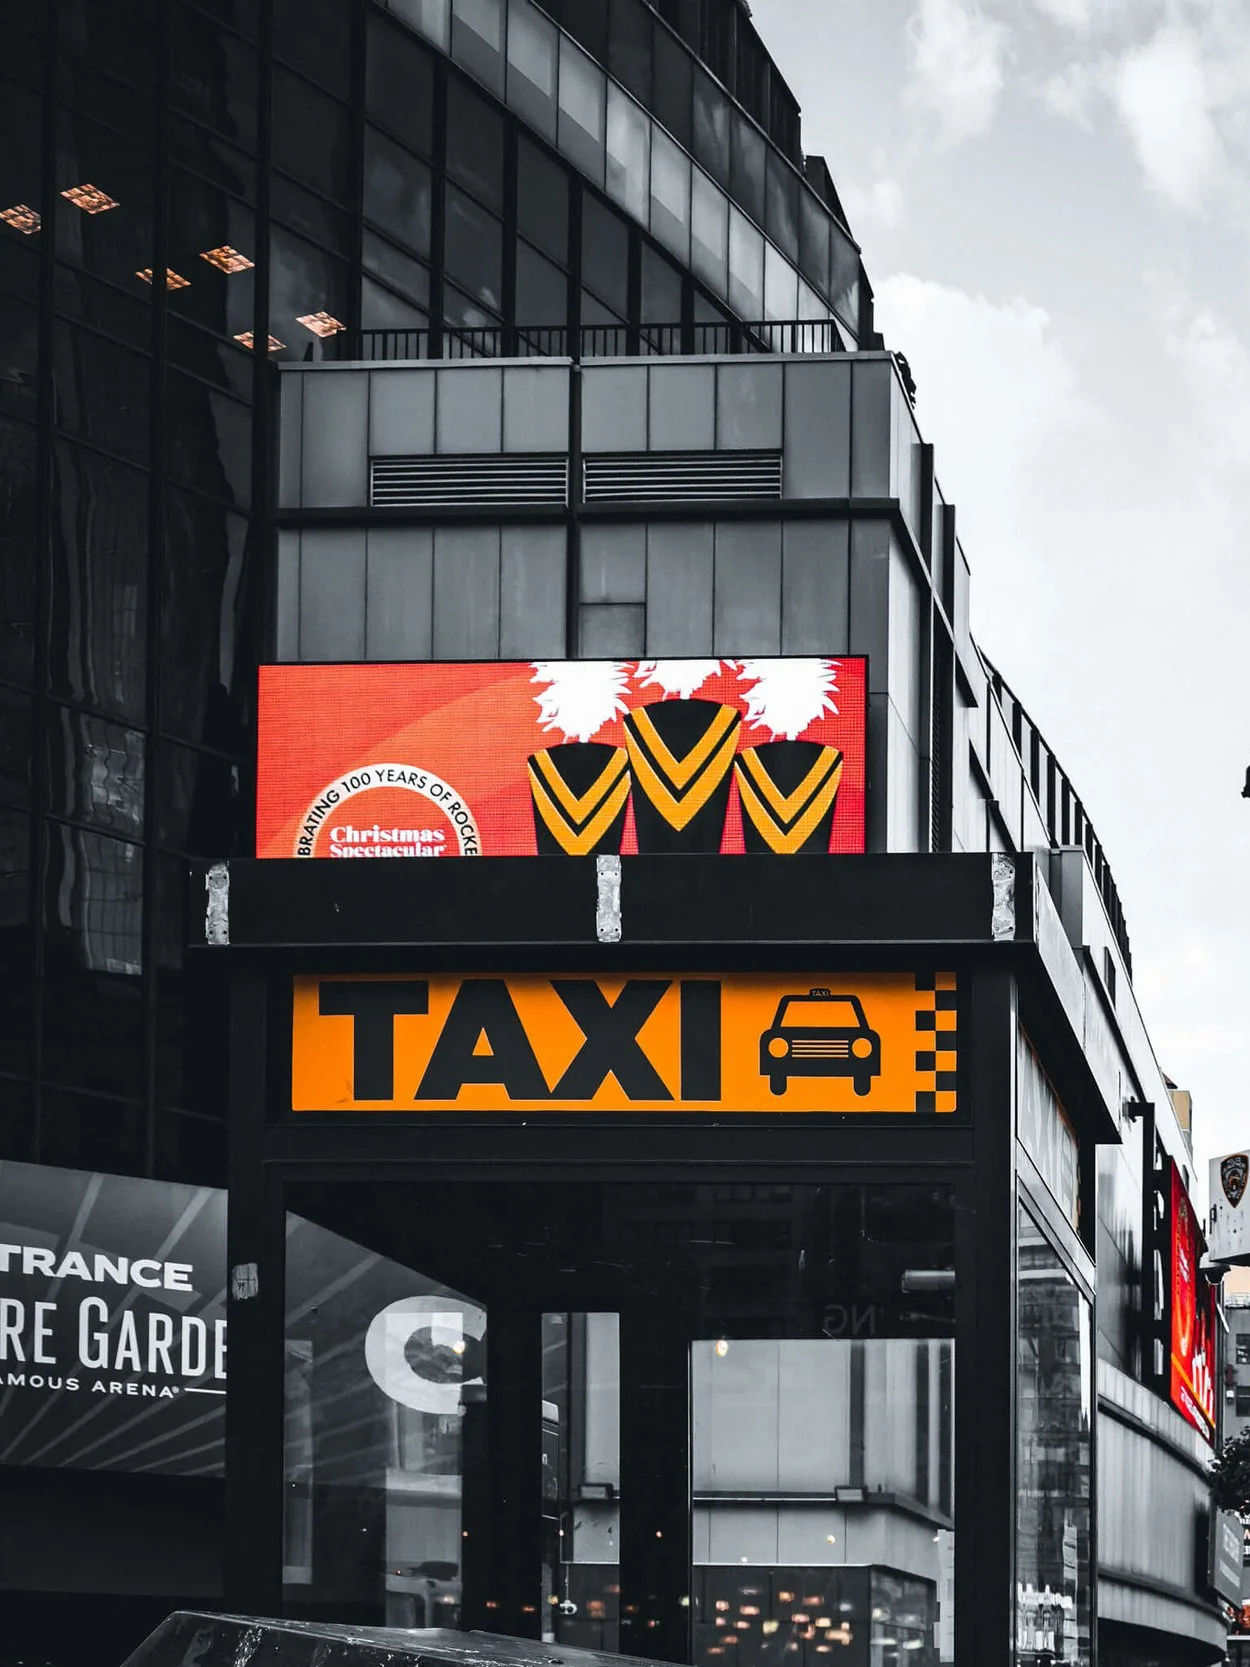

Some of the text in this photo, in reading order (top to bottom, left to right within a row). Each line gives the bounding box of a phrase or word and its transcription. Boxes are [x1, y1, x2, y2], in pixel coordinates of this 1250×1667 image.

[341, 772, 371, 793] 100
[375, 769, 427, 789] YEARS
[429, 783, 452, 802] OF
[329, 824, 444, 843] Christmas
[329, 842, 445, 858] Spectacular
[319, 980, 723, 1101] TAXI
[0, 1243, 193, 1292] TRANCE
[0, 1298, 57, 1364] RE
[0, 1373, 79, 1390] MOUS
